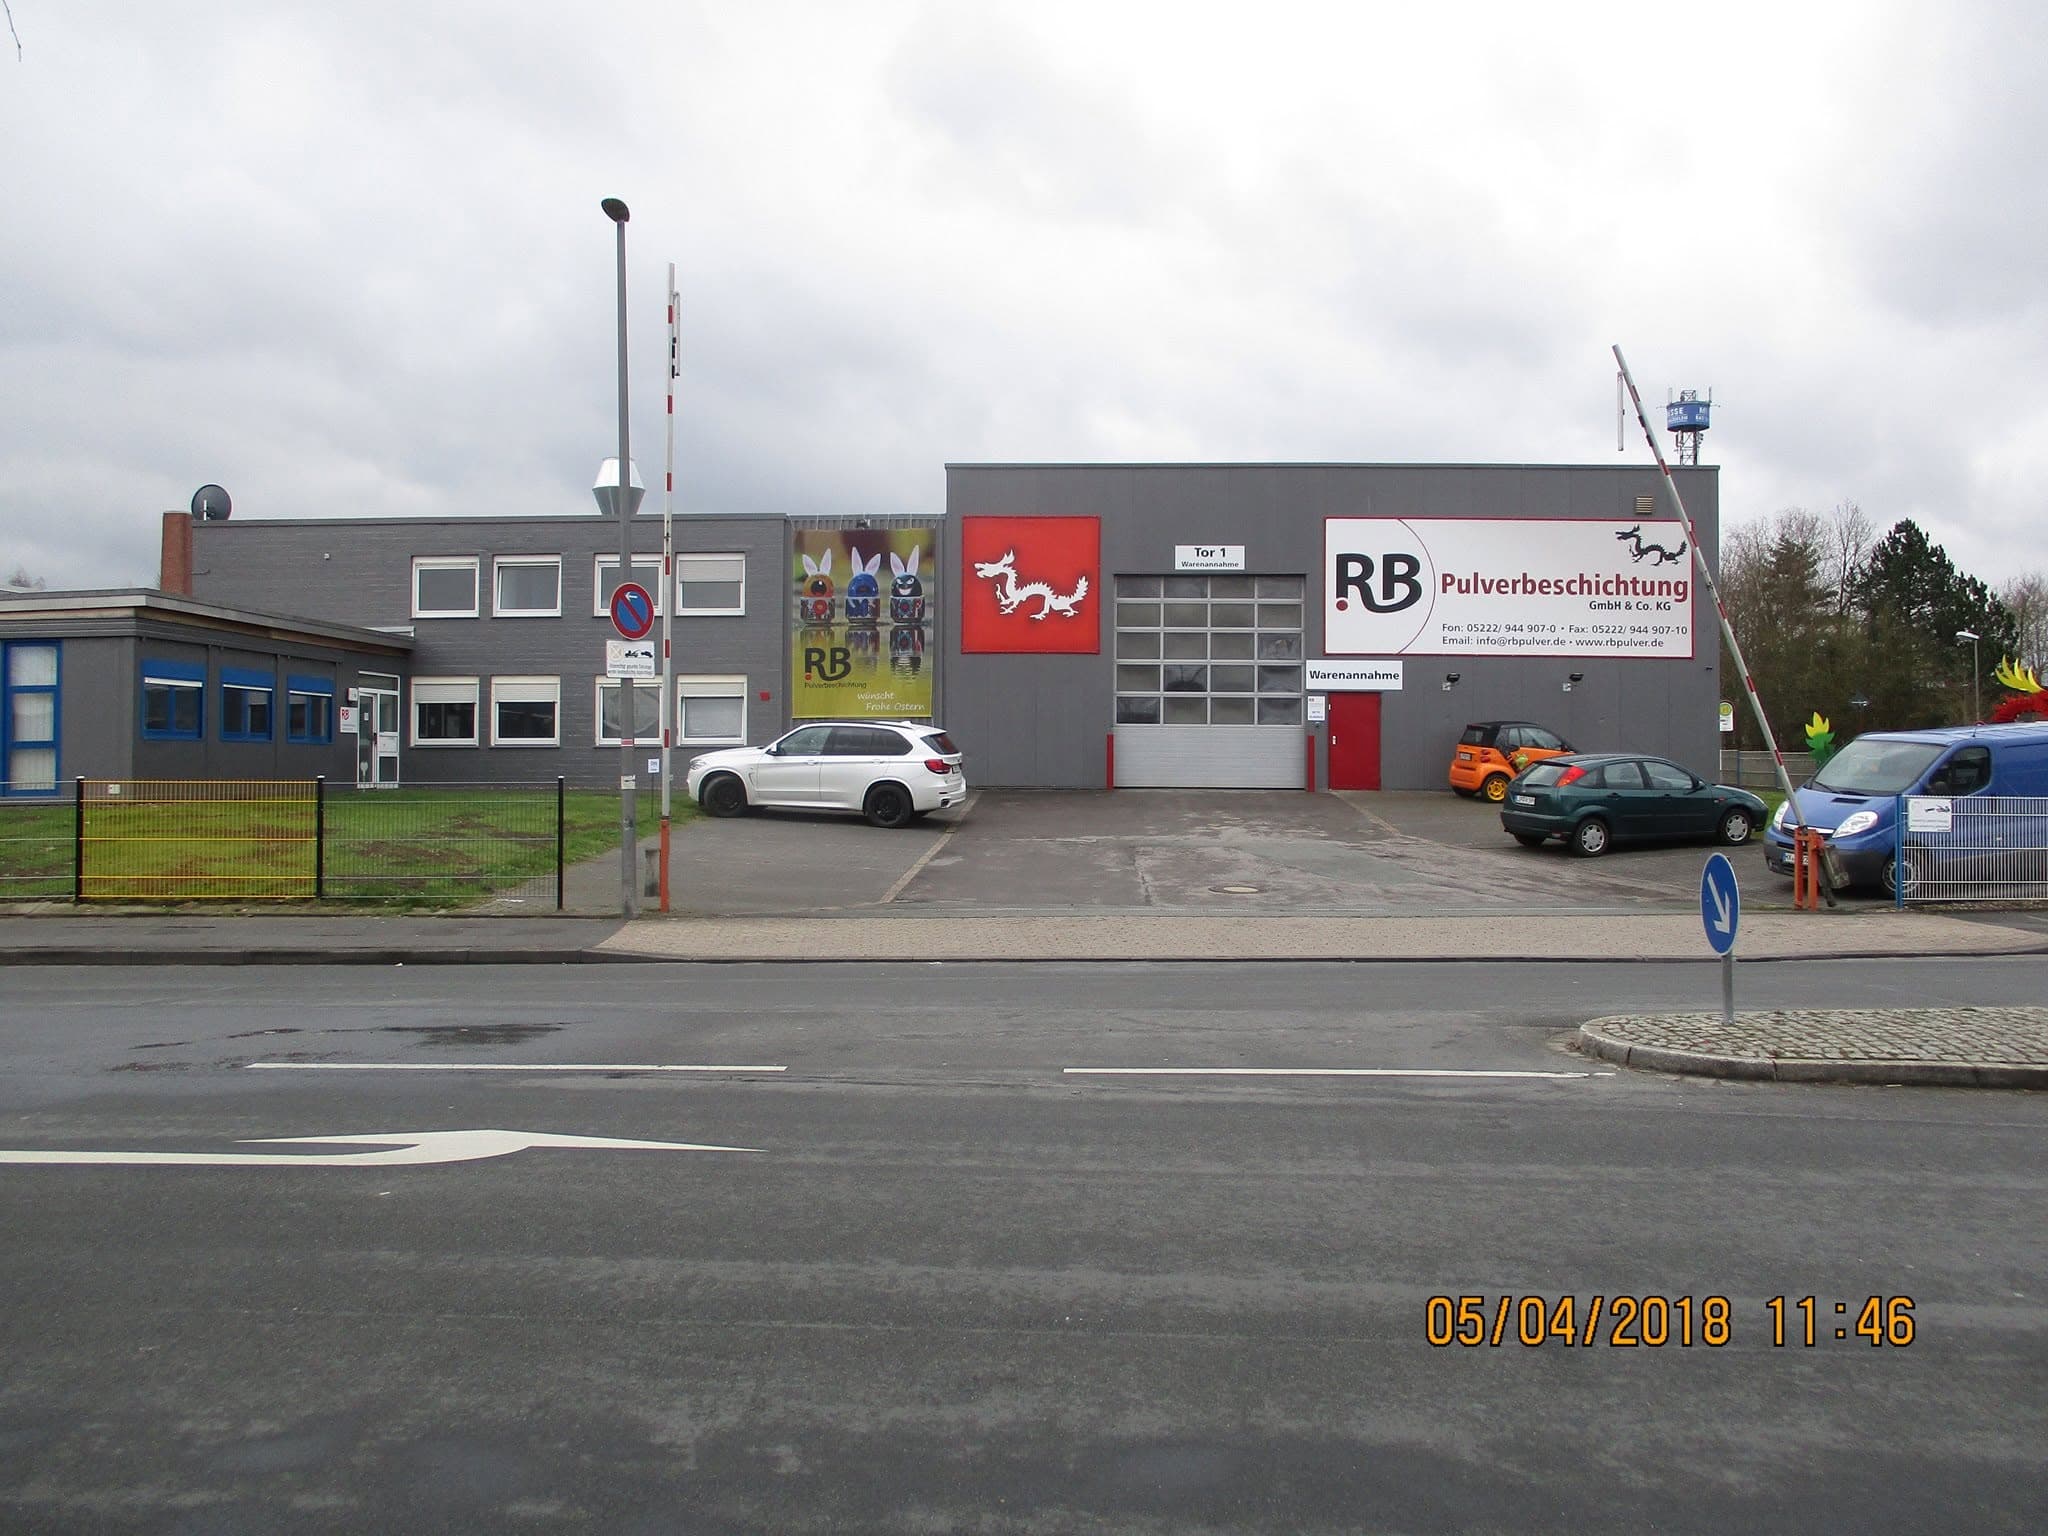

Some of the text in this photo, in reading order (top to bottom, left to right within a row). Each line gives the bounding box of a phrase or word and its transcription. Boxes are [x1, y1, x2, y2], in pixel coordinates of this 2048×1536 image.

[1194, 547, 1226, 557] Tor 1
[1335, 553, 1423, 613] RB
[1441, 572, 1688, 603] Pulverbeschichtung
[1589, 600, 1671, 611] GmbH & Co. KG
[1442, 623, 1688, 635] Fon: 05222/ 944 907-0 Fax: 05222/ 944 907-10
[1442, 636, 1664, 648] Email: info@rbpulver.de www.rbpulver.de
[804, 647, 851, 681] RB
[1309, 670, 1400, 680] Warenannahme
[865, 702, 925, 711] Frohe Ostern
